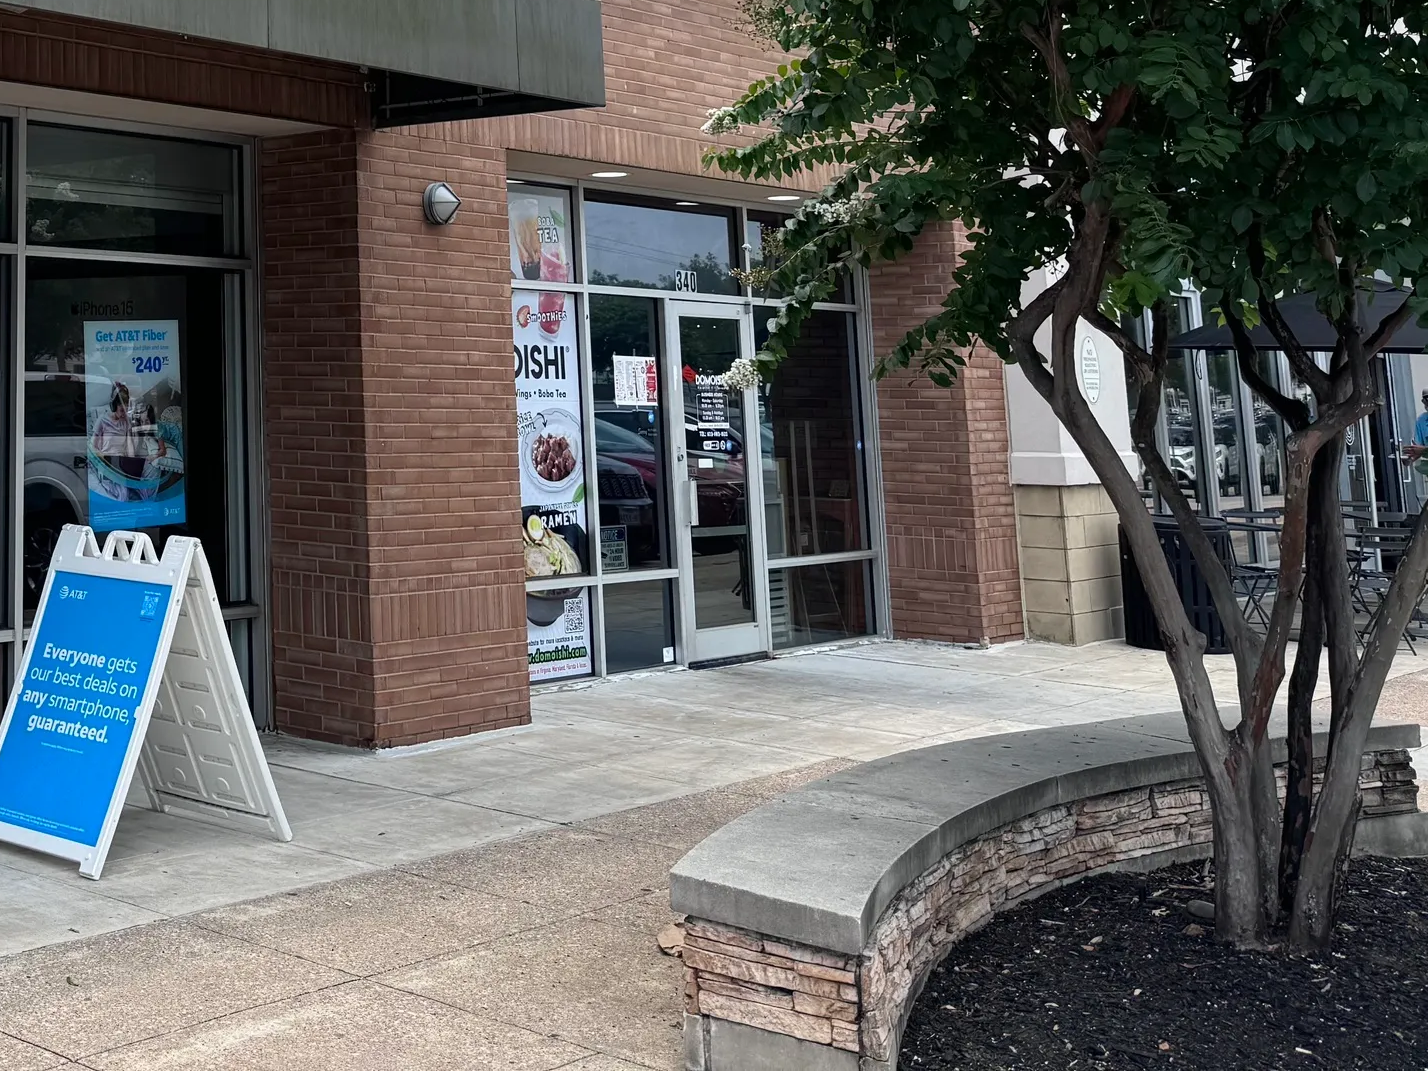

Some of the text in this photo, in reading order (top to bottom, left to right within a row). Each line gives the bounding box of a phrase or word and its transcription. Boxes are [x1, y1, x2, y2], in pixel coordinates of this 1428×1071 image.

[537, 216, 555, 226] BOBA
[537, 228, 559, 243] TEA
[676, 270, 696, 292] 340
[80, 301, 119, 316] iPhone
[96, 329, 165, 342] Get AT&T Fiber
[696, 374, 725, 386] DOMOIS
[538, 389, 554, 398] Boba
[556, 389, 567, 398] Tea
[541, 510, 577, 529] RAMEN
[69, 589, 88, 600] AT&T
[43, 642, 138, 674] Everyone gets
[30, 666, 138, 699] our best deals on
[22, 689, 130, 726] any smartphone,
[26, 714, 108, 744] guaranteed.
